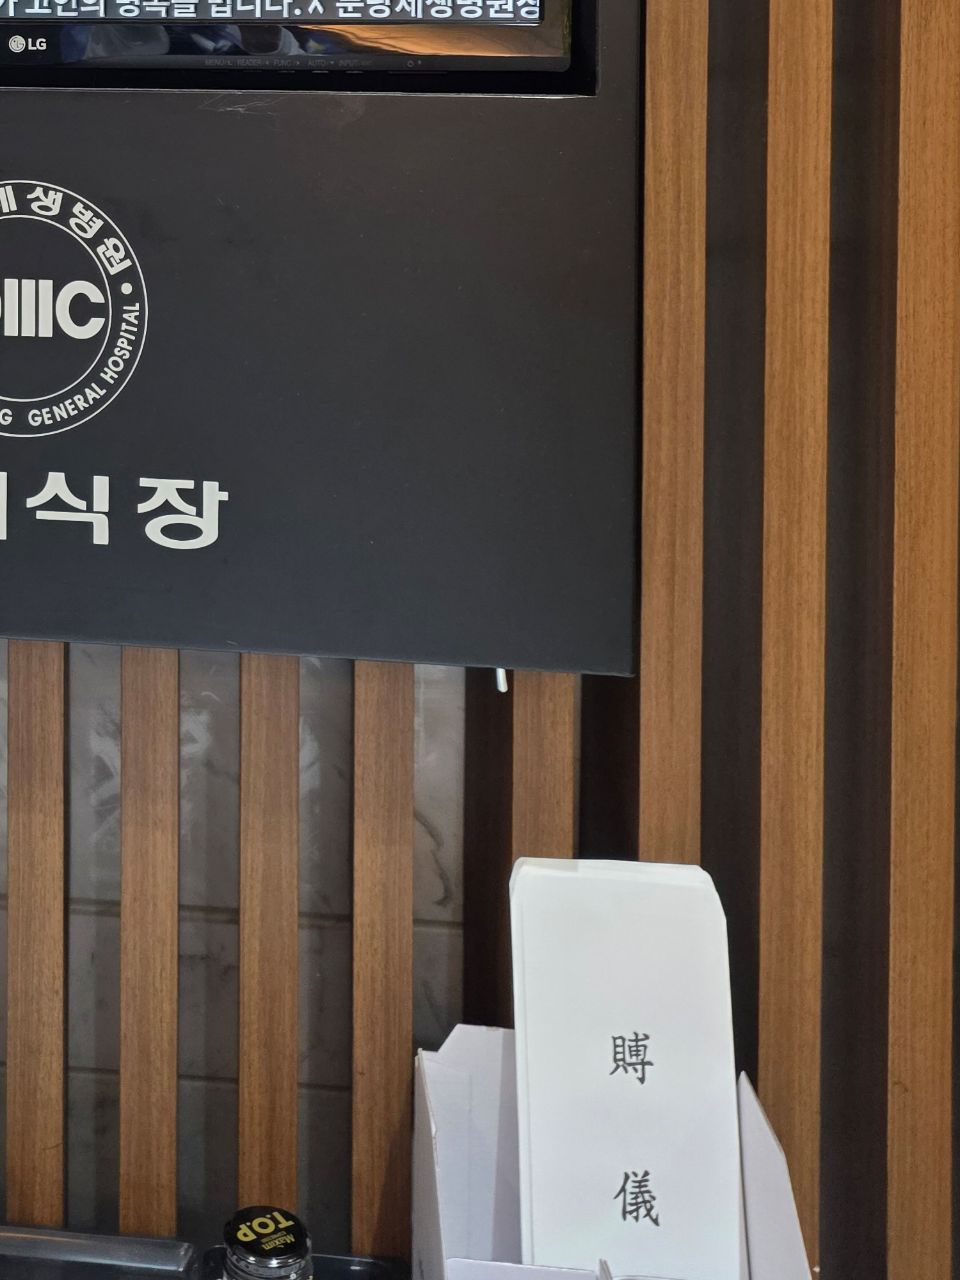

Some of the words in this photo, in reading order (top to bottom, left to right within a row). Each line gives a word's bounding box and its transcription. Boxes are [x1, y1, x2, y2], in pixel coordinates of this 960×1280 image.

[27, 37, 47, 51] LG
[27, 382, 107, 427] GENERAL
[105, 302, 140, 385] HOSPITAL
[261, 1233, 296, 1250] Maxim
